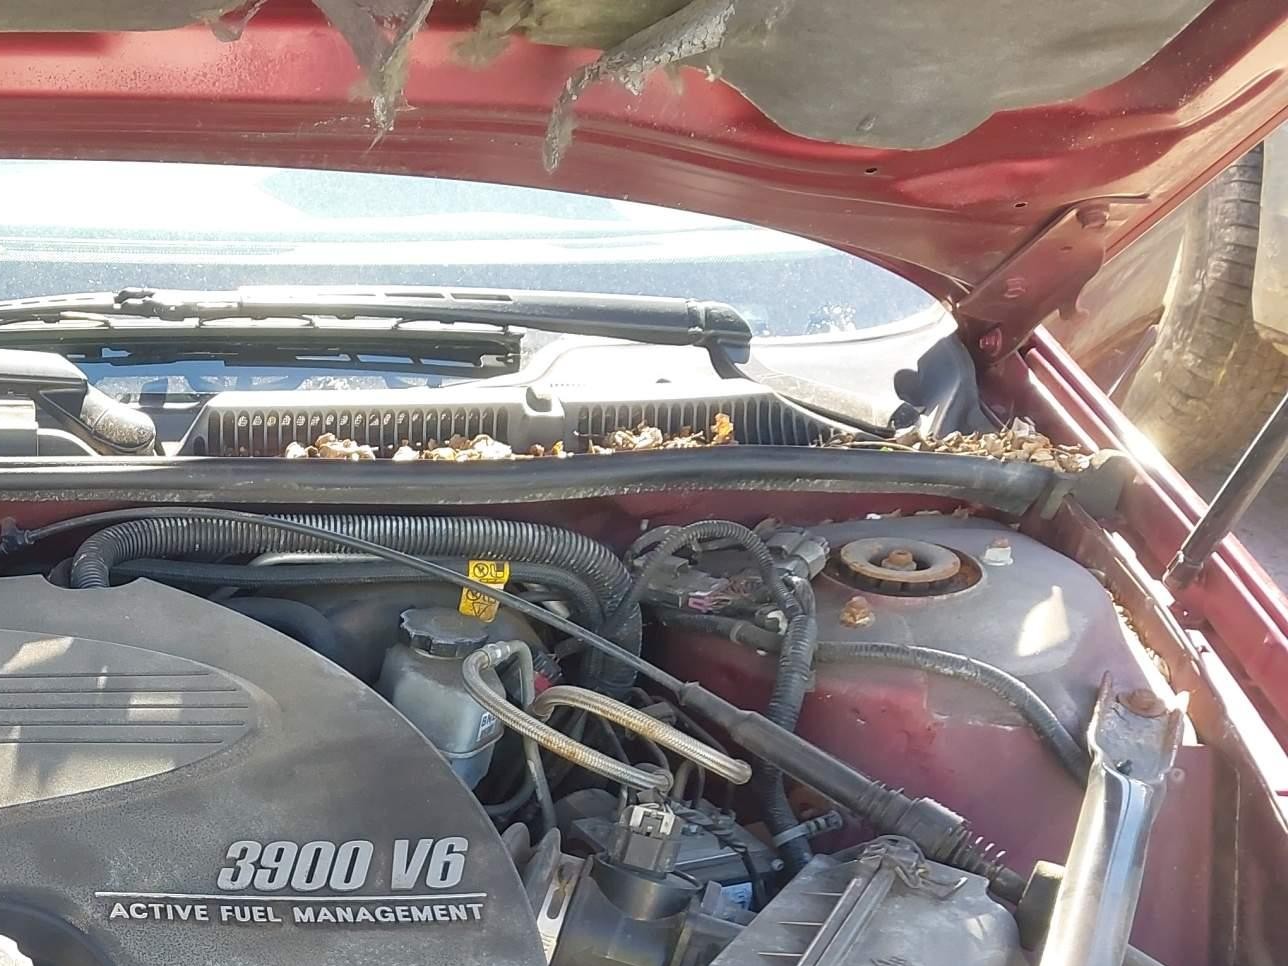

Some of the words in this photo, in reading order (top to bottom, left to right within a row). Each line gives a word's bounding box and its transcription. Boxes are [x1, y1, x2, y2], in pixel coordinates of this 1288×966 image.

[217, 840, 374, 891] 3900
[391, 837, 469, 889] V6
[110, 902, 209, 921] ACTIVE
[220, 905, 282, 922] FUEL
[293, 903, 483, 923] MANAGEMENT
